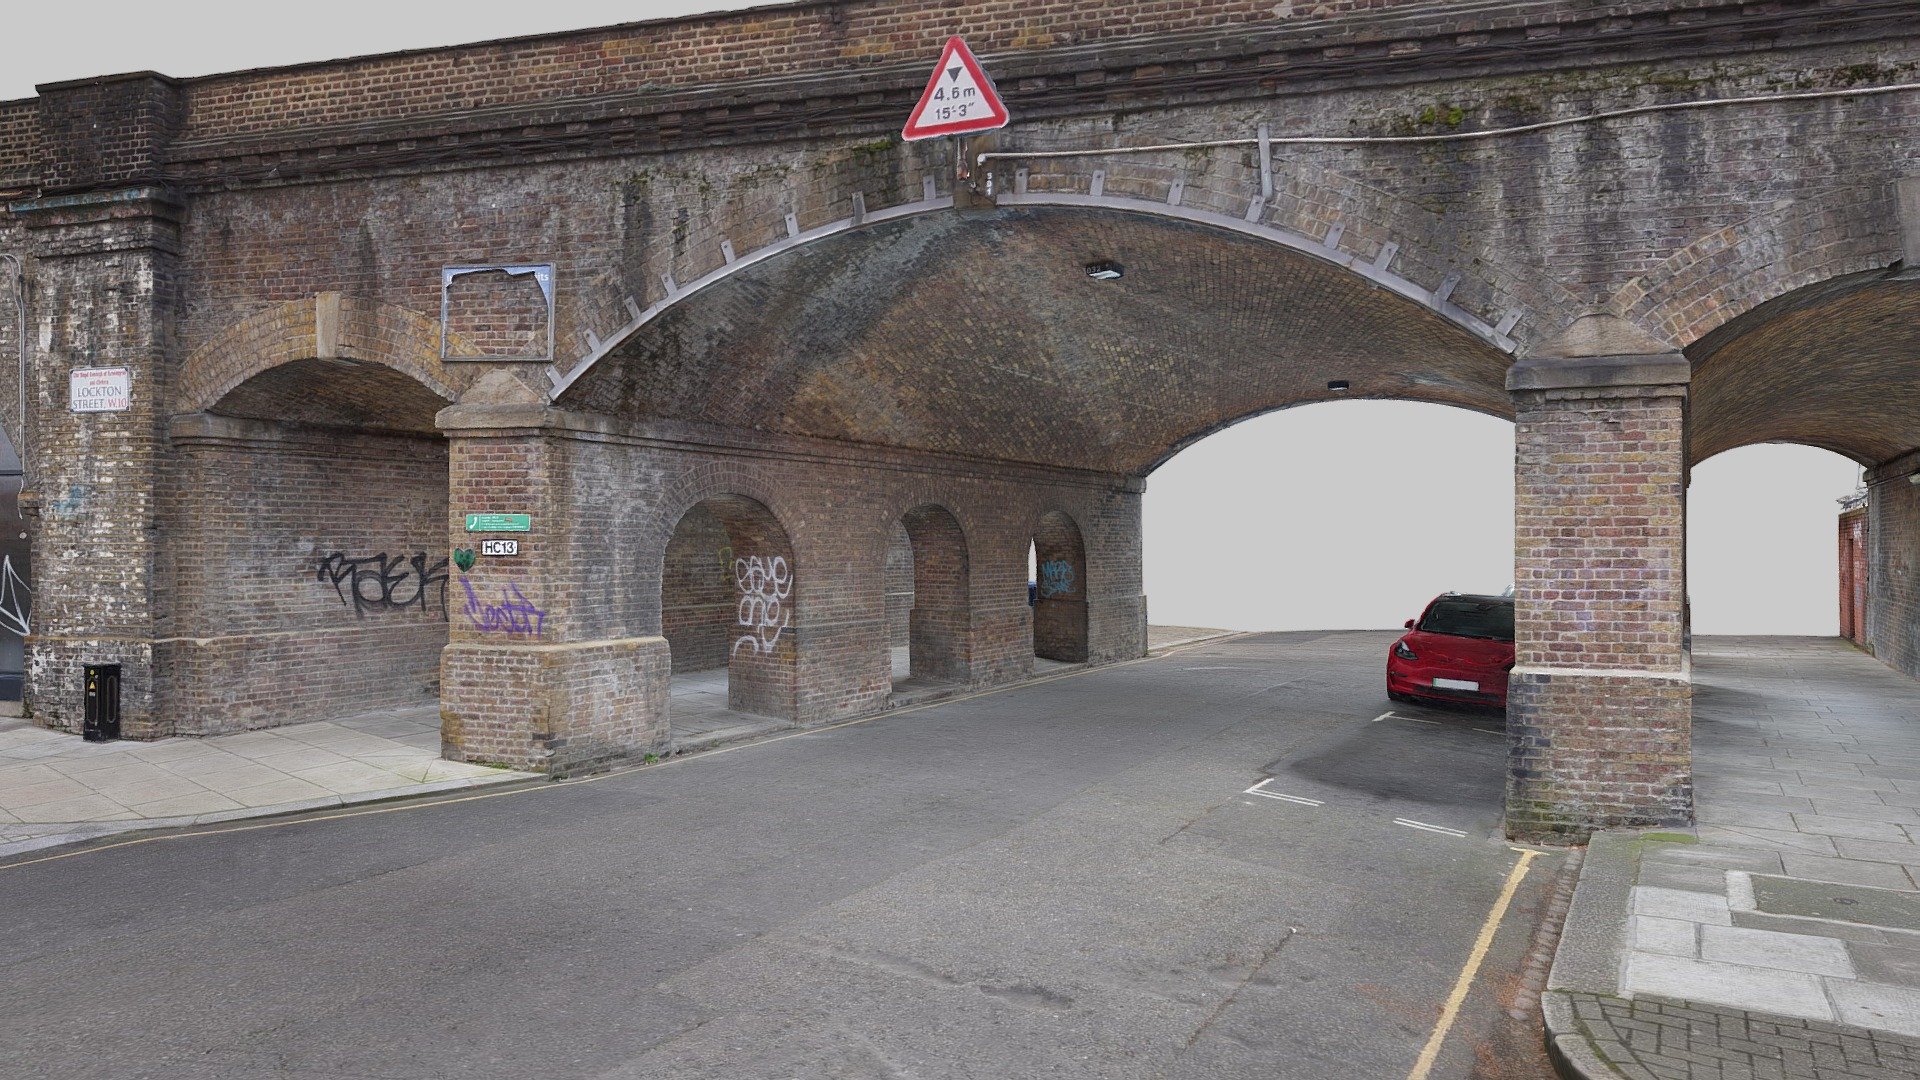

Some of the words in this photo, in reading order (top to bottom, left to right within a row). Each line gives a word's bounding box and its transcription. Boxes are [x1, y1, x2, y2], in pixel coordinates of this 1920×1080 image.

[933, 87, 960, 101] 4.6
[963, 87, 976, 97] m
[77, 386, 121, 397] LOCKTON
[107, 398, 127, 408] W.10
[485, 541, 514, 554] HC13
